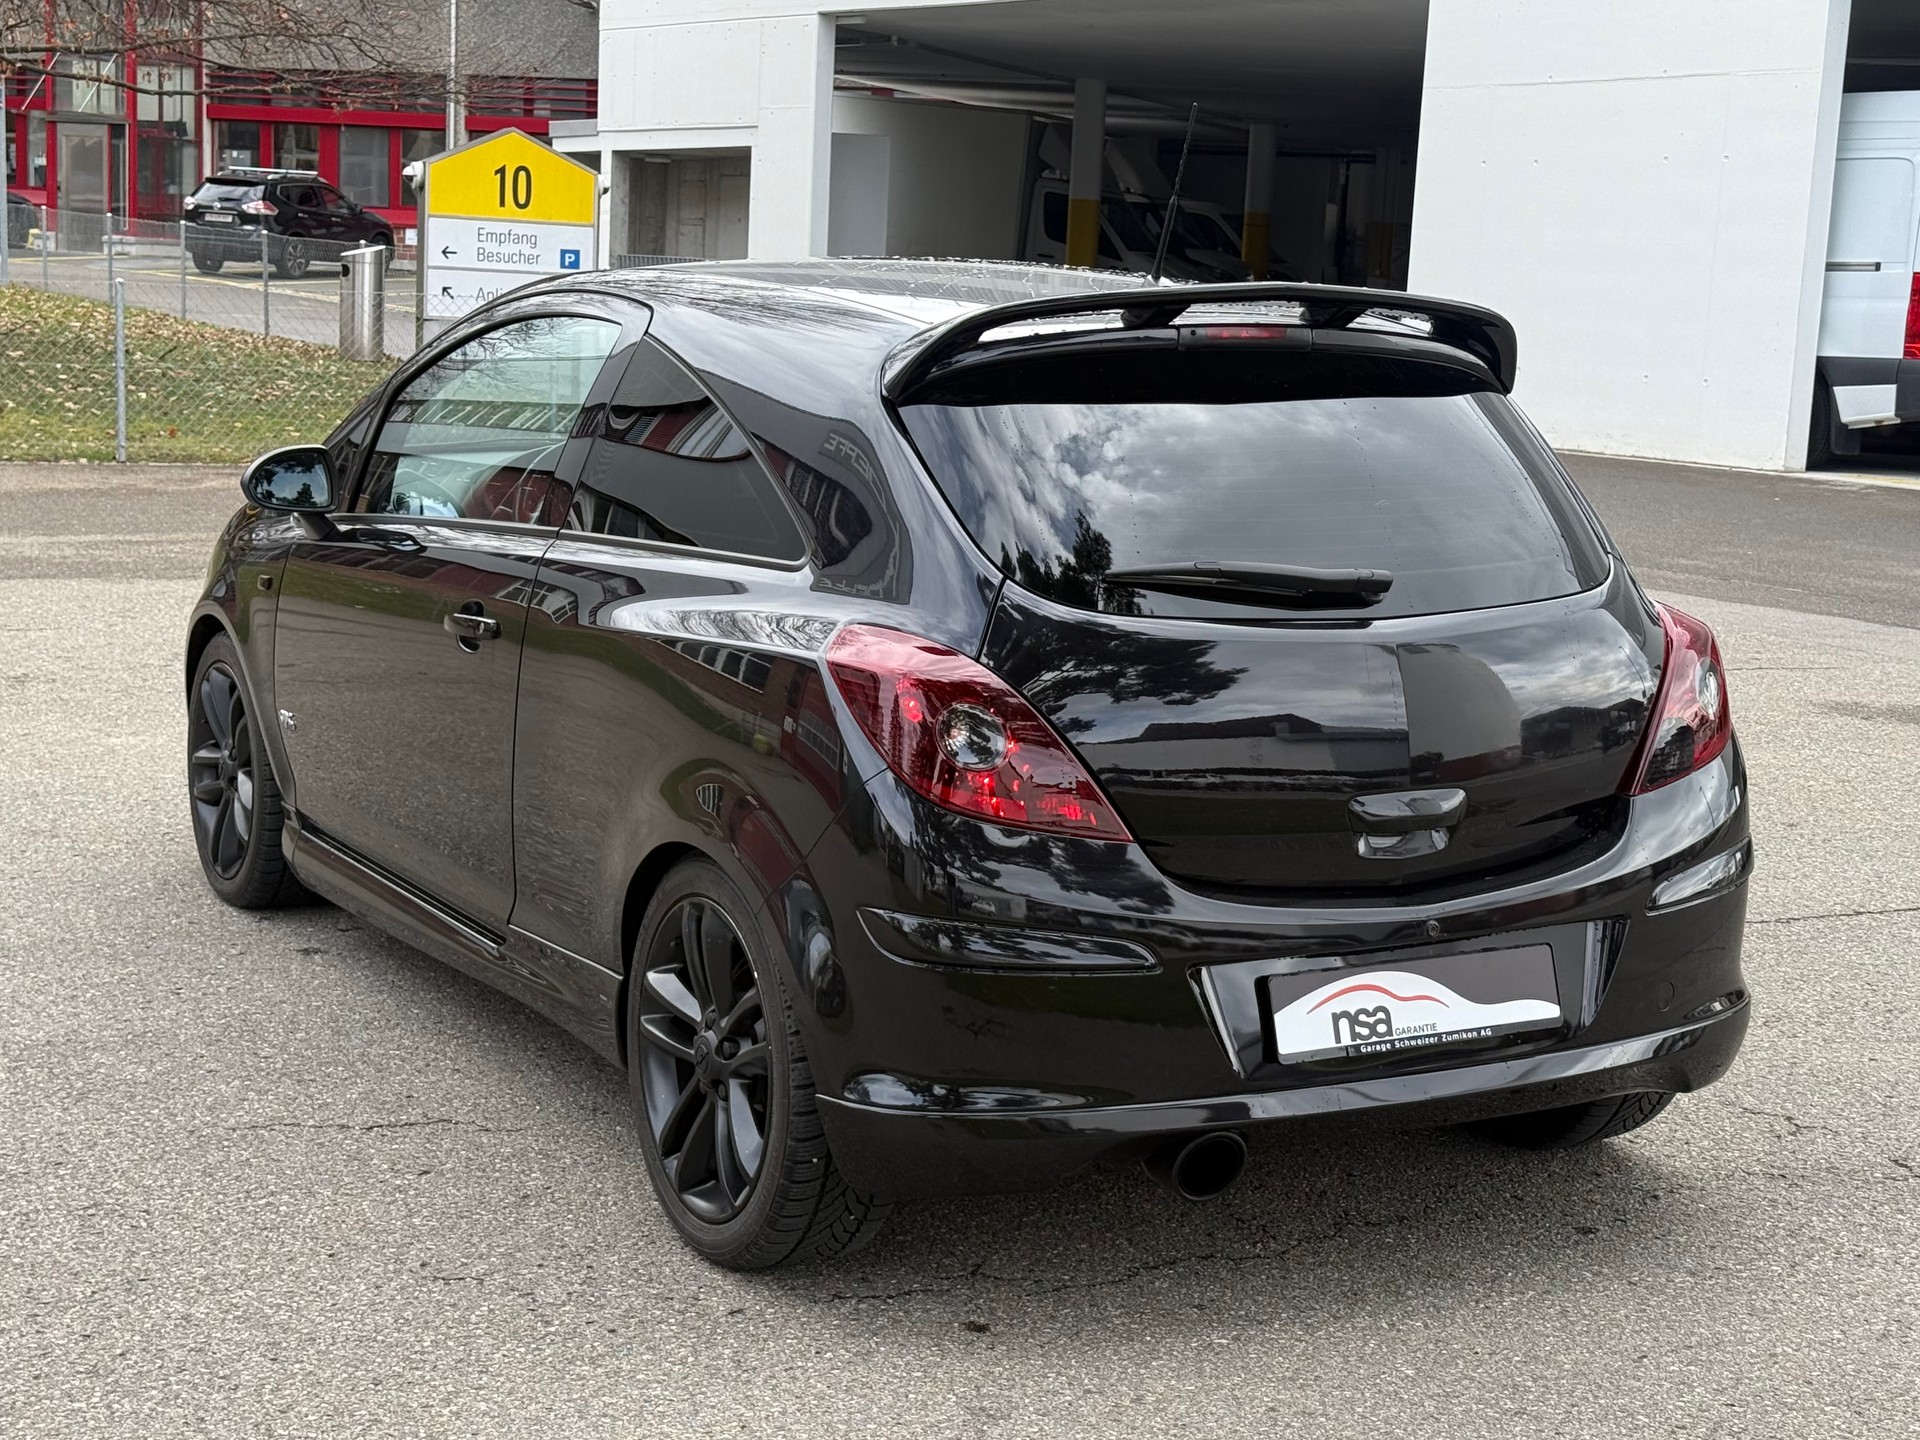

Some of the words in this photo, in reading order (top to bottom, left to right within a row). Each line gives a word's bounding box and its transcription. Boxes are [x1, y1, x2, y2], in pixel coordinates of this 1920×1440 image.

[494, 164, 532, 210] 10
[477, 227, 538, 249] Empfang
[477, 247, 541, 265] Besucher
[475, 287, 503, 303] Anli
[1331, 1005, 1394, 1045] nsa
[1394, 1022, 1438, 1037] GARANTIE
[1360, 1042, 1392, 1053] Garage
[1394, 1036, 1439, 1049] Schweizer
[1442, 1031, 1478, 1043] Zumikon
[1480, 1027, 1492, 1037] AG
